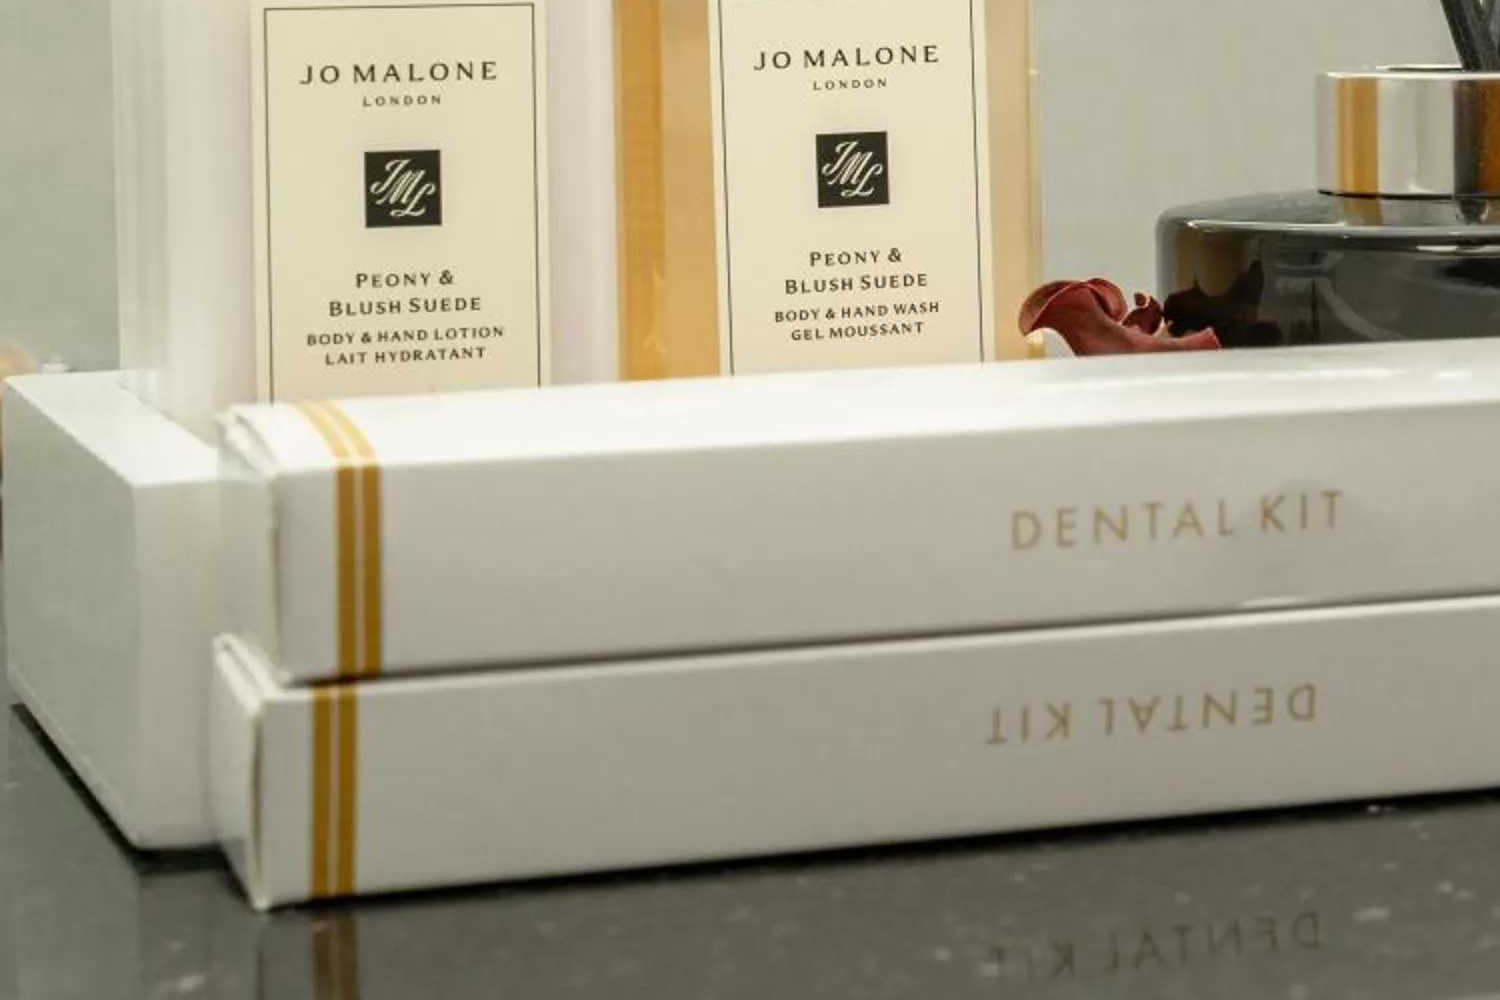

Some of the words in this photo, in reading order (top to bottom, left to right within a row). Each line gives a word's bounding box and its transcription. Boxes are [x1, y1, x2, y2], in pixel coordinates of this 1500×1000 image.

[753, 51, 792, 71] JO
[803, 45, 939, 69] MALONE
[299, 65, 340, 85] JO
[353, 61, 498, 83] MALONE
[813, 77, 888, 91] LONDON
[362, 95, 442, 107] LONDON
[809, 251, 881, 267] PEONY
[888, 248, 902, 263] &
[355, 272, 432, 288] PEONY
[439, 270, 454, 286] &
[785, 278, 853, 295] BLUSH
[860, 273, 928, 290] SUEDE
[329, 300, 401, 317] BLUSH
[409, 297, 481, 313] SUEDE
[775, 309, 820, 323] BODY
[825, 309, 836, 320] &
[841, 304, 888, 318] HAND
[894, 302, 940, 314] WASH
[307, 332, 355, 346] BODY
[361, 332, 372, 343] &
[377, 329, 428, 343] HAND
[434, 326, 504, 340] LOTION
[791, 328, 825, 341] GEL
[829, 322, 924, 339] MOUSSANT
[325, 352, 367, 365] LAIT
[375, 347, 486, 364] HYDRATANT
[1011, 498, 1234, 550] DENTAL
[1259, 490, 1343, 533] KIT
[1098, 683, 1318, 736] DENTAL
[987, 702, 1072, 745] KIT
